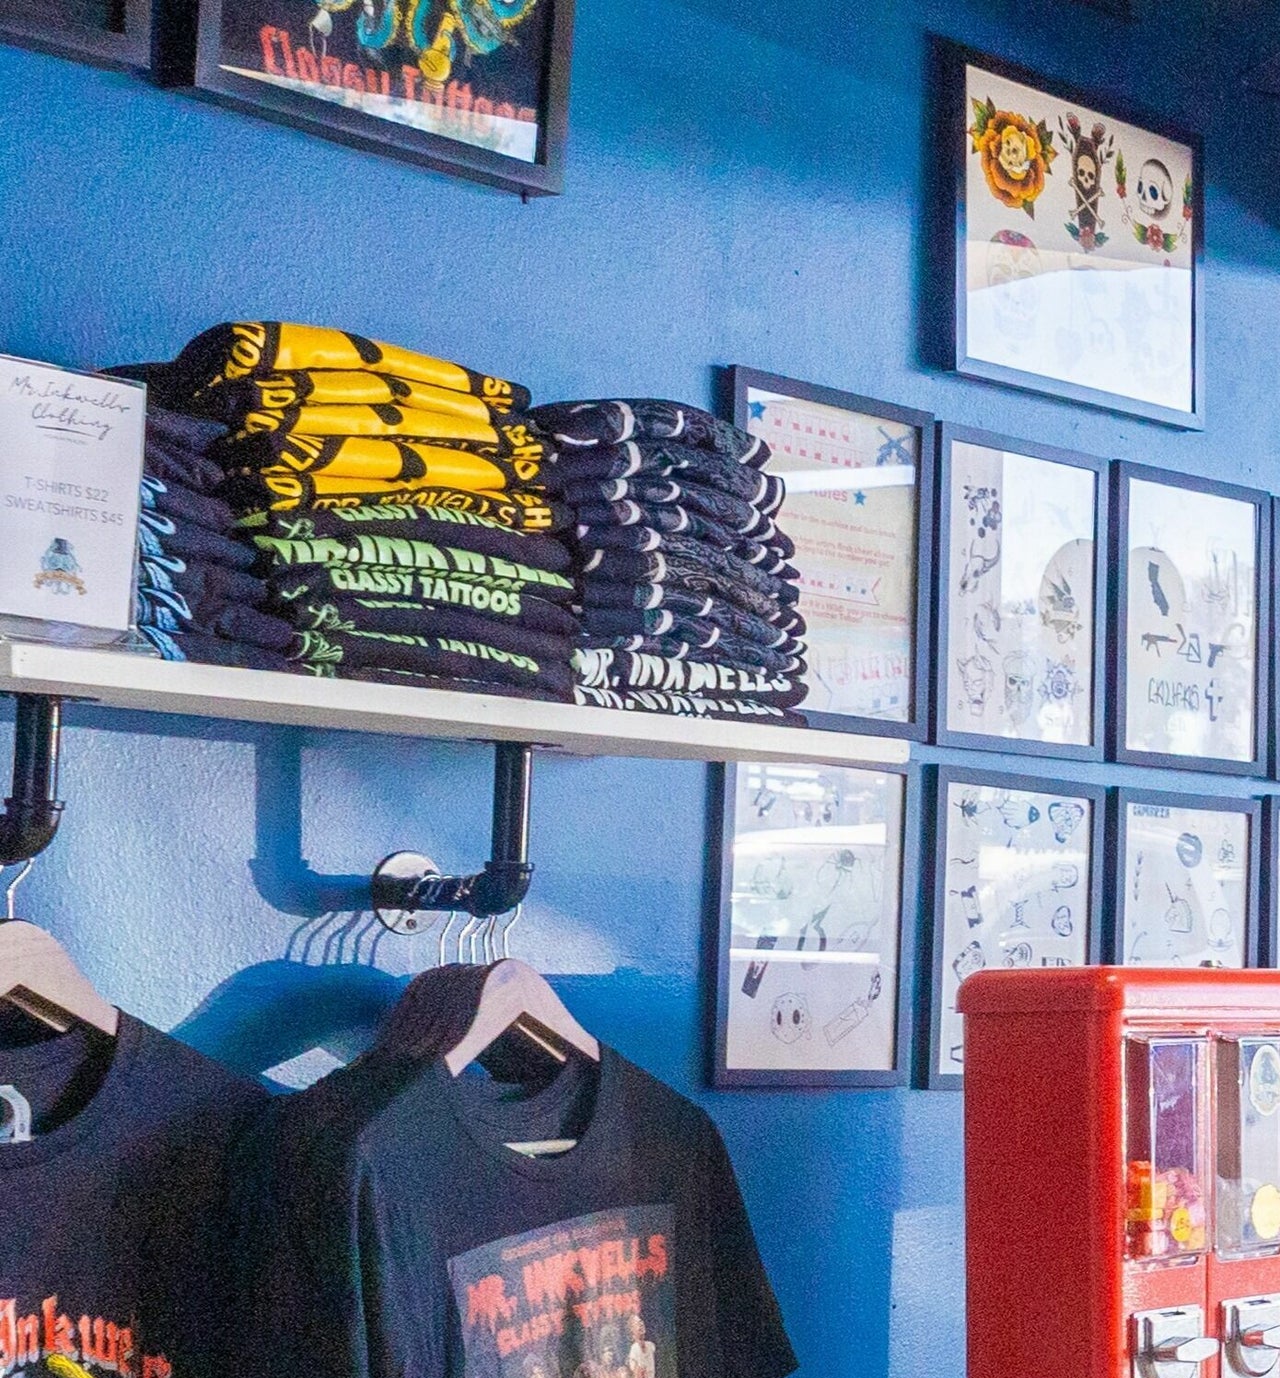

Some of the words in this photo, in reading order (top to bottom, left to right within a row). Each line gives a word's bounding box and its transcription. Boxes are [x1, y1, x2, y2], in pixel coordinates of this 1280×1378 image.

[4, 493, 98, 523] SWEATSHIRTS
[101, 512, 125, 527] $45
[24, 475, 83, 499] T-SHIRTS
[85, 486, 109, 503] $22
[330, 567, 416, 598] CLASSY
[419, 575, 523, 617] TATTOOS
[522, 1233, 669, 1309] INKWELLS
